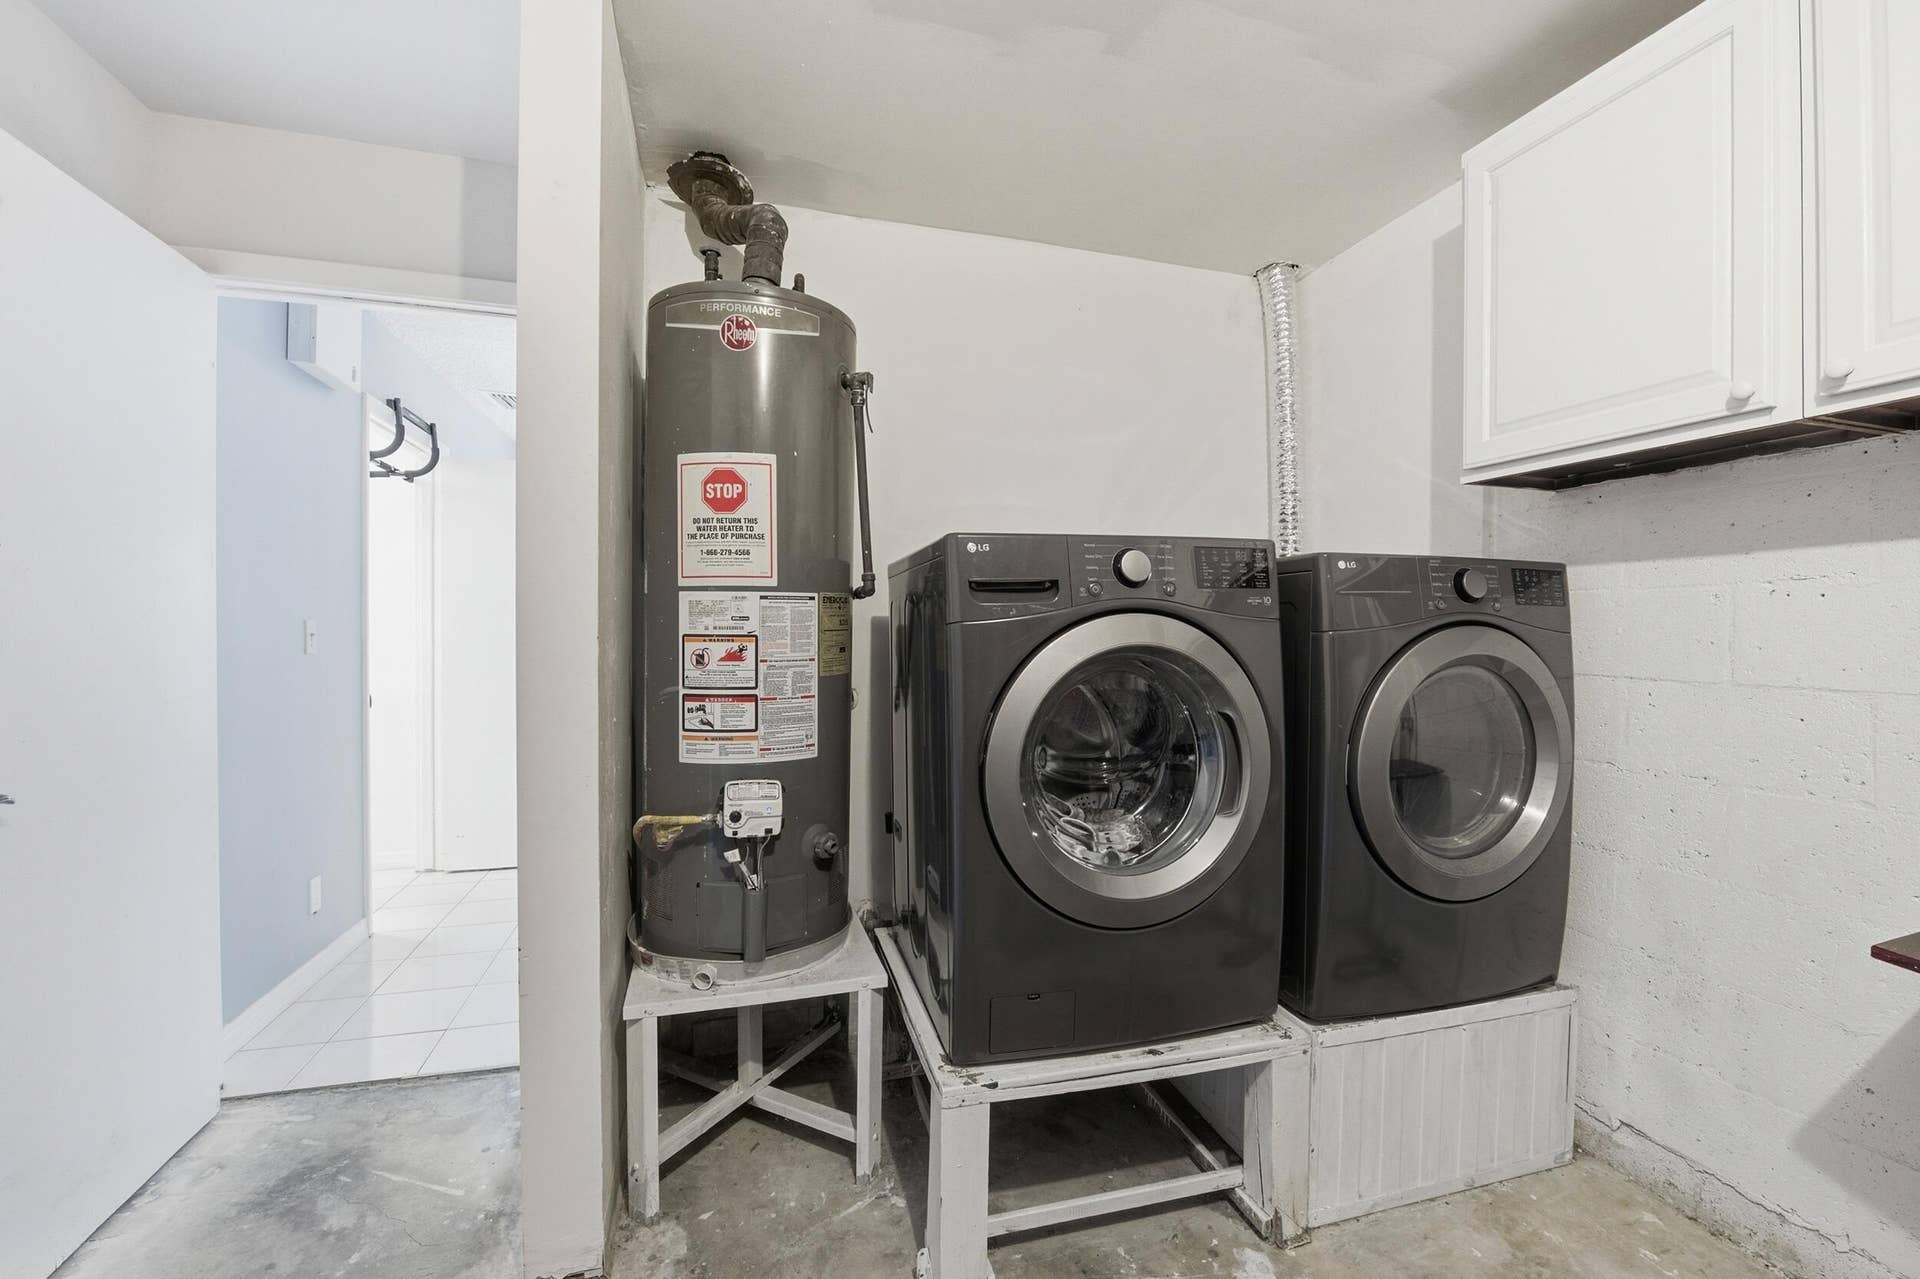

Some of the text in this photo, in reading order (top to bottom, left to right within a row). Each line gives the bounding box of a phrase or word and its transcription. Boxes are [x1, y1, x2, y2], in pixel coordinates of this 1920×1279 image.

[700, 302, 782, 318] PERFORMANCE
[724, 316, 755, 346] Rheem
[706, 483, 743, 499] STOP
[730, 533, 766, 541] PURCHASE
[977, 543, 990, 552] LG
[1346, 561, 1357, 569] LG
